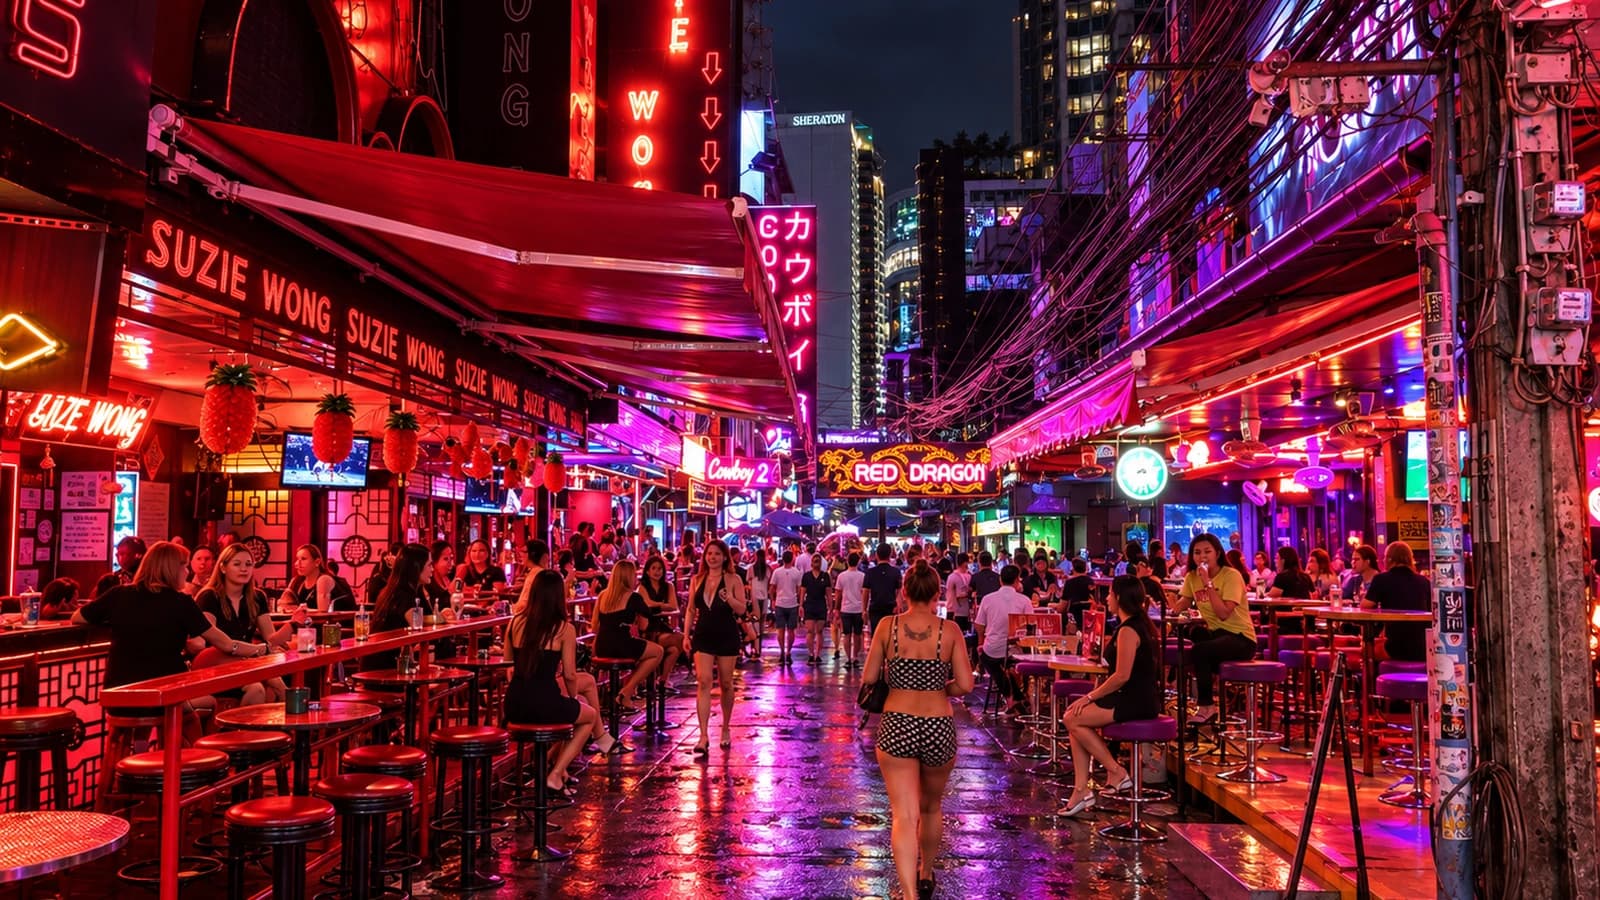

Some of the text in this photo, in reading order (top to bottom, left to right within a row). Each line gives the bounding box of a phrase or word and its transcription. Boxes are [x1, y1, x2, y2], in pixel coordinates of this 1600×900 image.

[793, 113, 846, 126] SHERATON
[628, 90, 660, 190] WO
[145, 218, 249, 302] SUZIE
[262, 269, 331, 334] WONG
[346, 308, 399, 361] SUZIE
[406, 334, 446, 379] WONG
[455, 358, 487, 396] SUZIE
[492, 374, 519, 408] WONG
[87, 400, 147, 450] WONG
[708, 457, 769, 488] Cowboy 2
[854, 463, 986, 482] RED DRAGON
